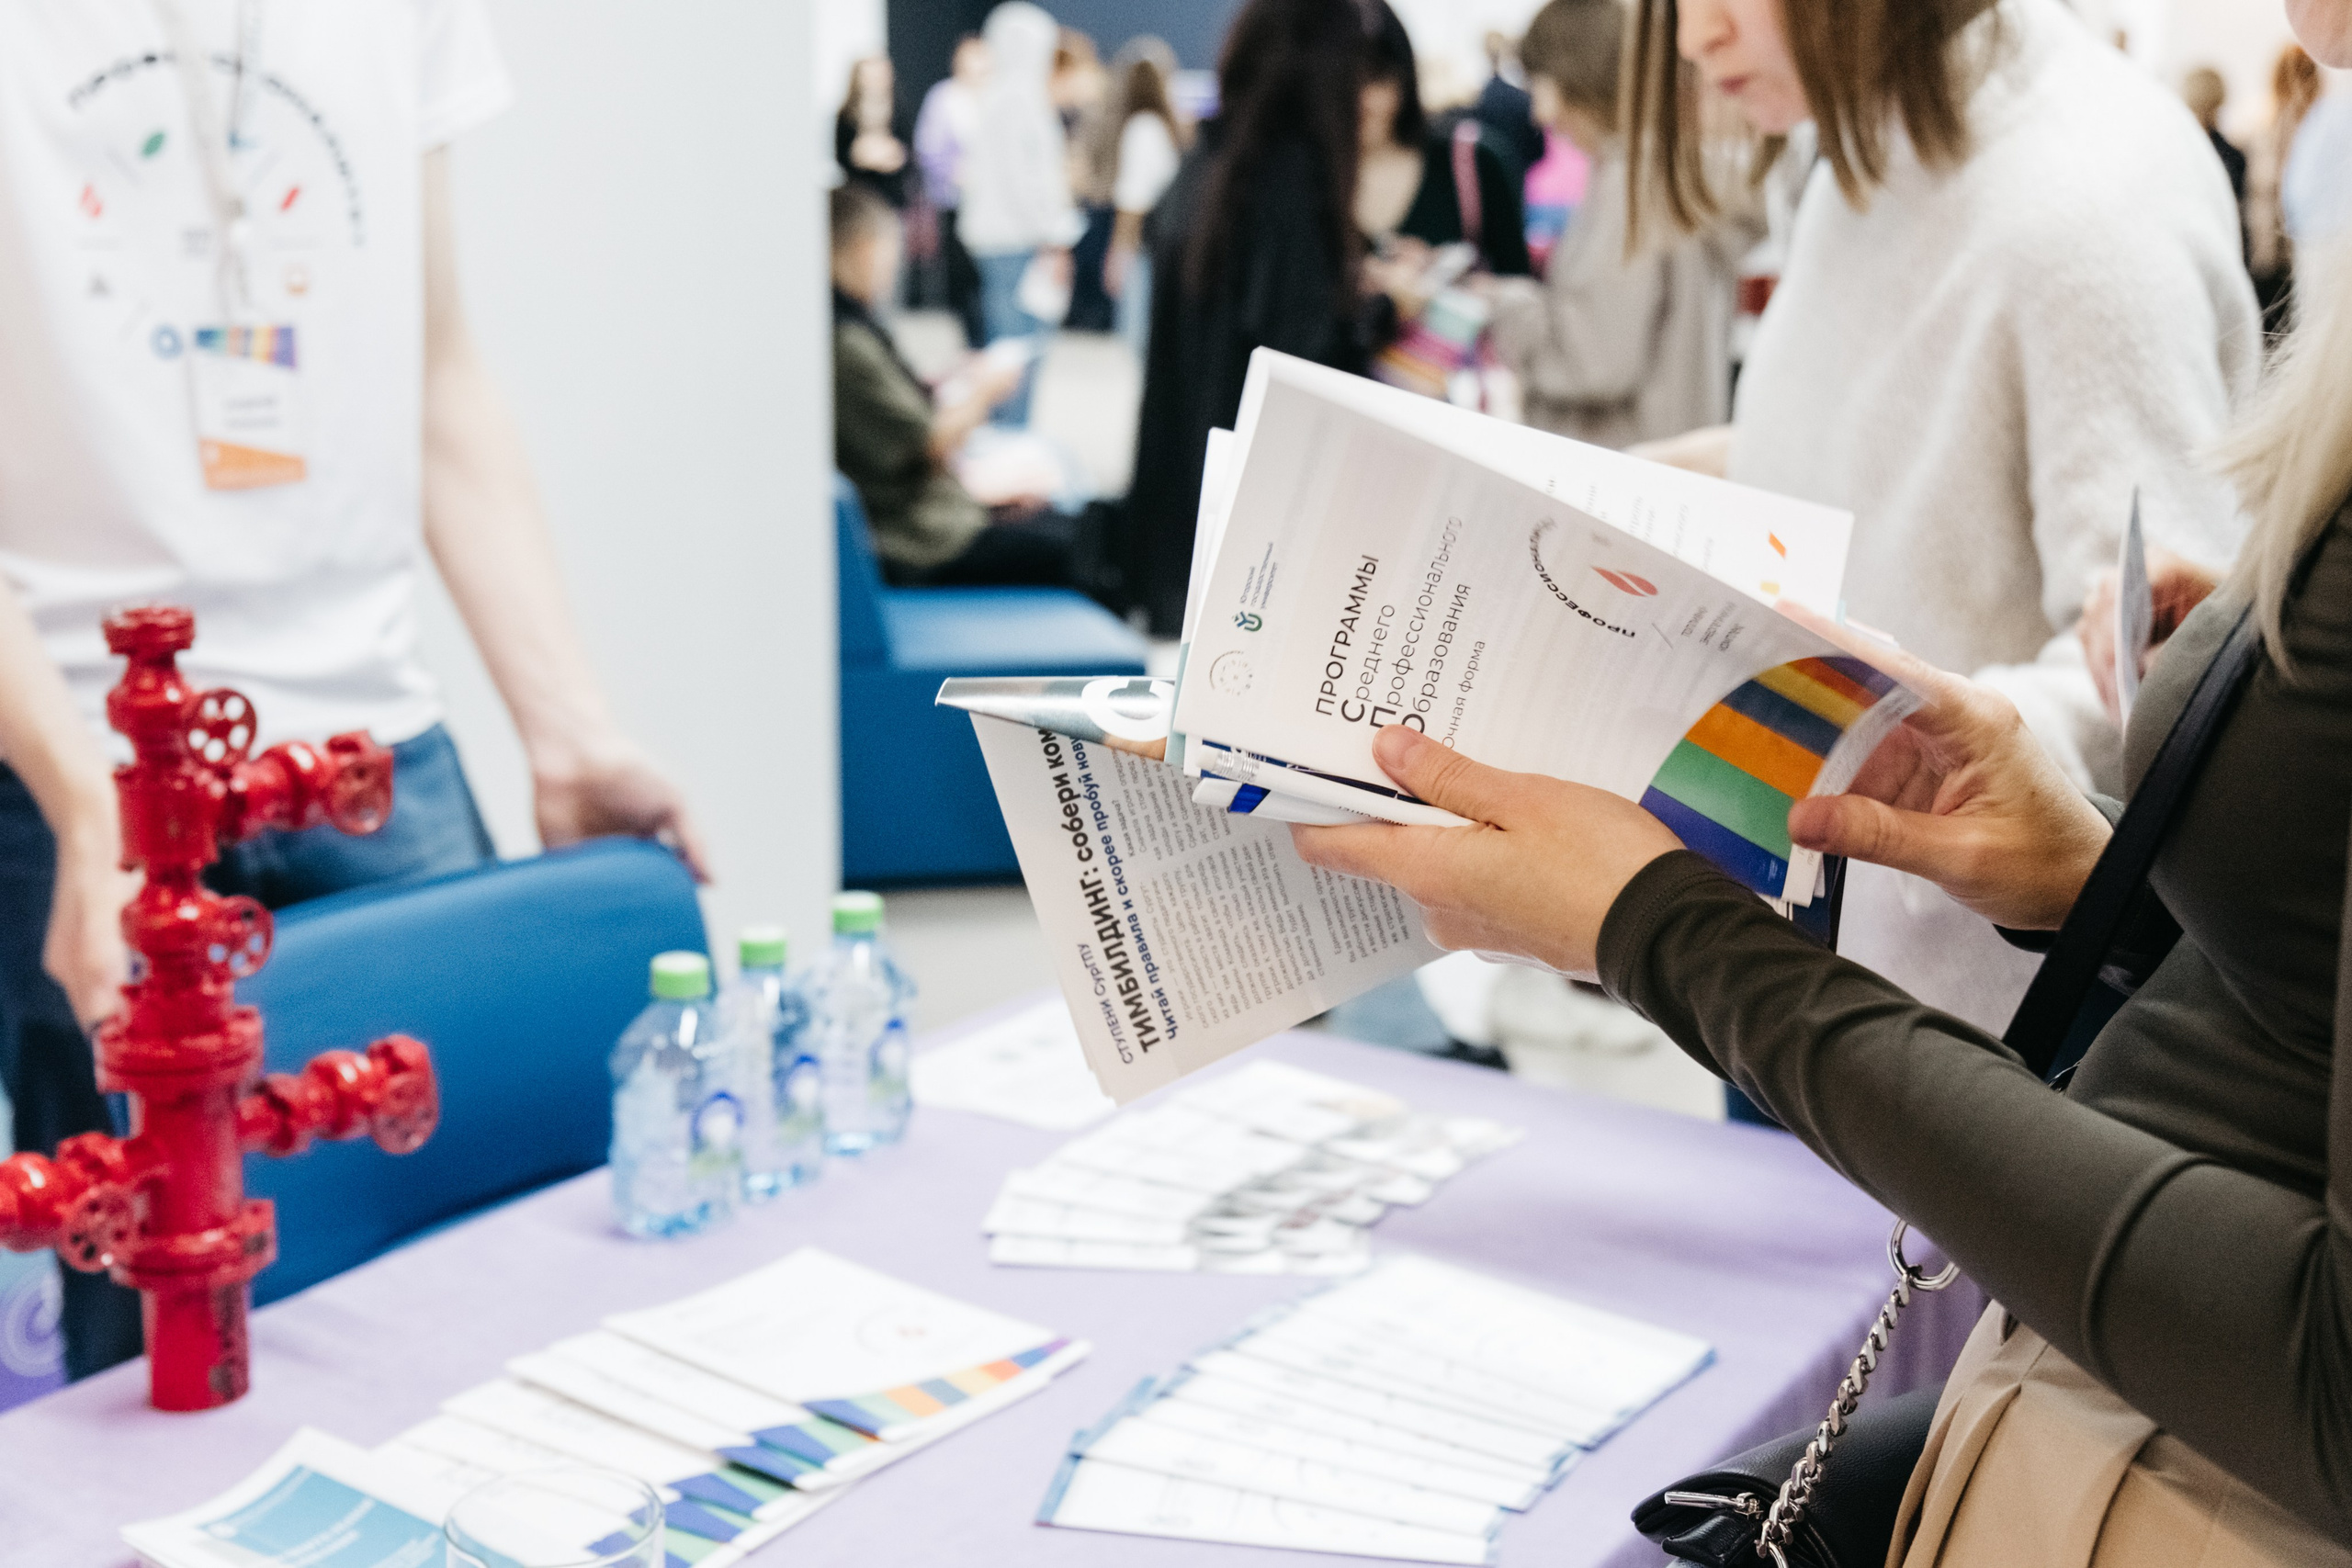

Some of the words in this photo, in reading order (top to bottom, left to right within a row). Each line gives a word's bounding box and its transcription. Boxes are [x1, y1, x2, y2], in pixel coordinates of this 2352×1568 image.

[1315, 554, 1378, 715] ПРОГРАММЫ
[1369, 516, 1462, 728] Профессионального
[1340, 604, 1394, 721] Среднего
[1457, 639, 1486, 692] форма
[1052, 772, 1092, 862] собери
[1077, 772, 1109, 832] пробуй
[1100, 833, 1127, 896] скорее
[1122, 898, 1133, 910] и
[1077, 943, 1105, 995] СурГПУ
[1079, 866, 1160, 1053] ТИМБИЛДИНГ:
[1125, 912, 1159, 984] правила
[1099, 998, 1133, 1064] СТУПЕНИ
[1150, 986, 1177, 1040] Читай
